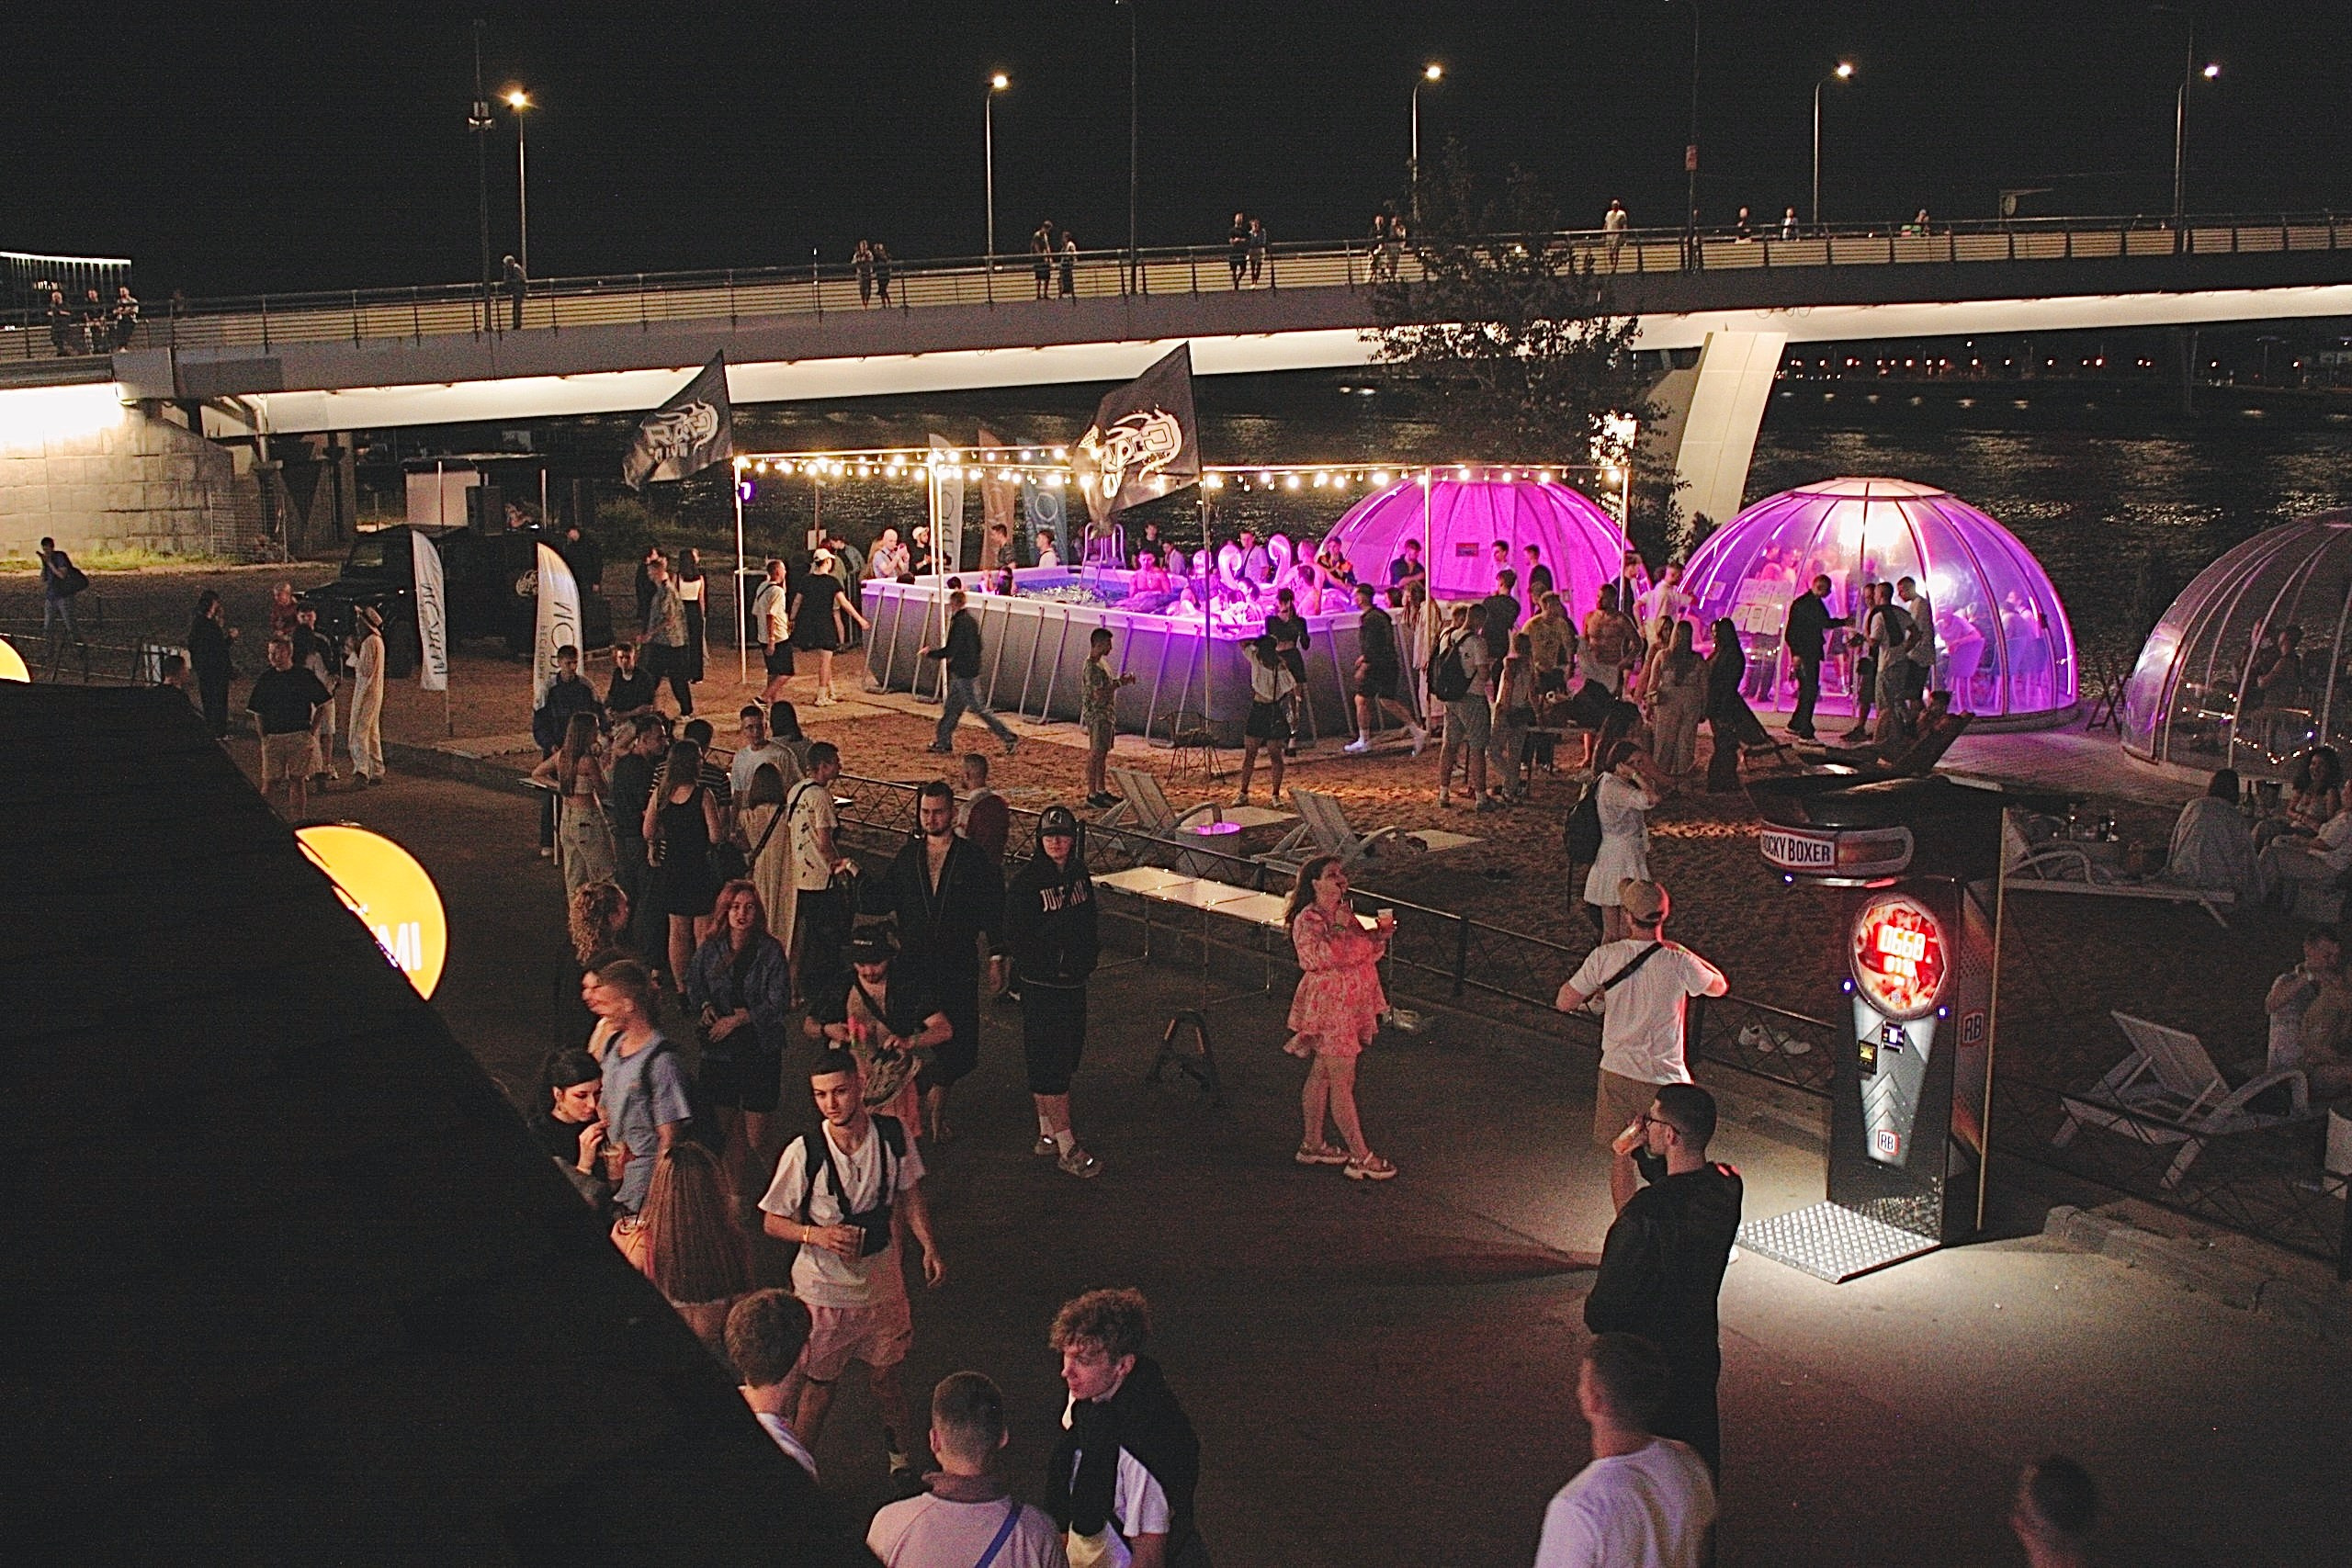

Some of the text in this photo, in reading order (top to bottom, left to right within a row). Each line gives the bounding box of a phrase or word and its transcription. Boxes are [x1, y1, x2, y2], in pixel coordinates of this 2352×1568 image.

[1788, 837, 1831, 863] BOXER
[1964, 1015, 1982, 1042] RB
[1881, 1134, 1894, 1150] RB
